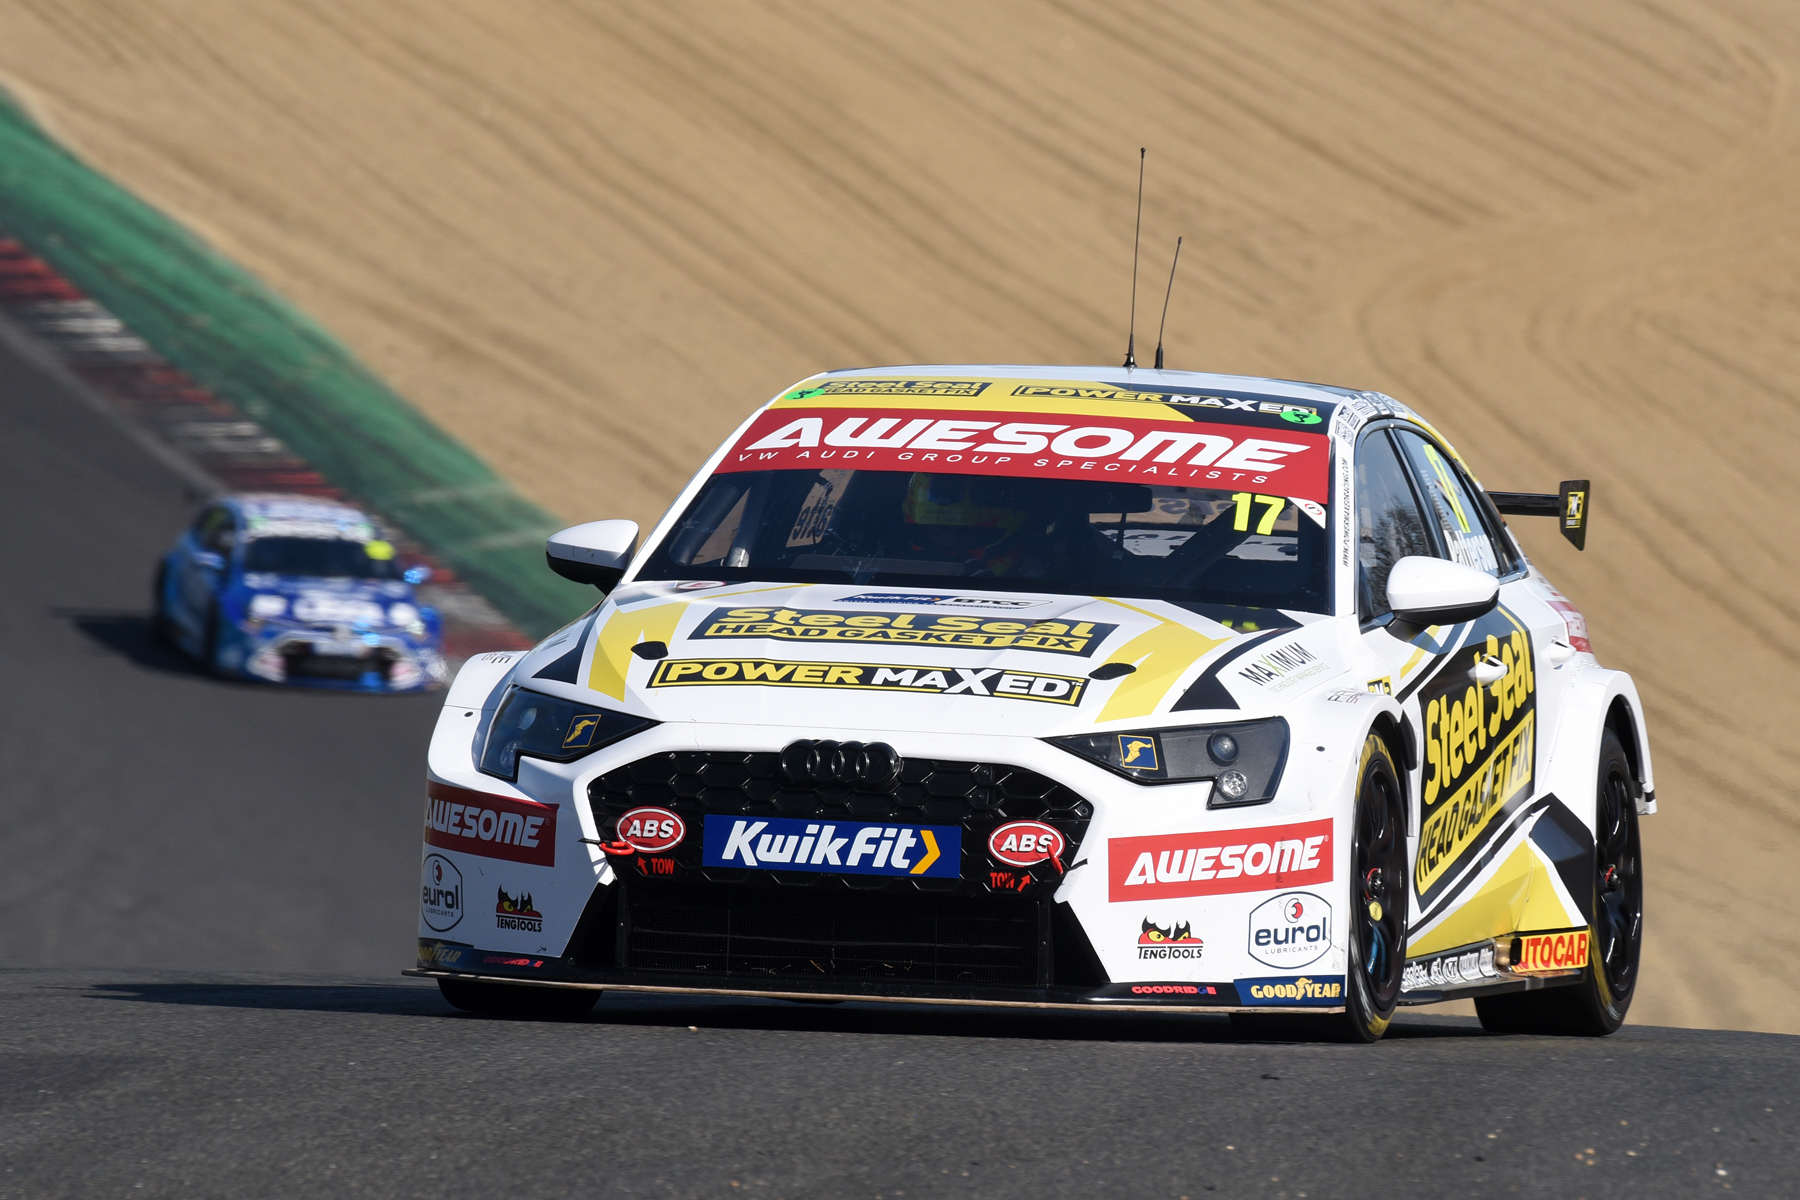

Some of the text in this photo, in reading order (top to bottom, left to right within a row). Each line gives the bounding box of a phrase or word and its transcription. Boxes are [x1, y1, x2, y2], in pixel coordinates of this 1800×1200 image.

[825, 381, 984, 390] Steel Seal
[1025, 386, 1164, 402] POWER
[744, 417, 1311, 473] AWESOME
[739, 450, 1269, 484] VW AUDI GROUP SPECIALISTS
[1232, 492, 1285, 536] 17
[712, 624, 1083, 649] HEAD GASKET FIX
[717, 607, 1097, 638] Steel Seal
[1238, 642, 1318, 687] MAXIMUM
[665, 662, 864, 684] POWER
[870, 668, 1071, 697] MAXED
[1424, 651, 1487, 806] Steel
[1418, 800, 1461, 883] HEAD
[1508, 720, 1532, 790] FIX
[626, 819, 675, 838] ABS
[1000, 834, 1054, 853] ABS
[651, 857, 675, 875] TOW
[1123, 834, 1325, 886] AWESOME
[990, 872, 1015, 889] TOW
[422, 885, 460, 909] eurol
[425, 907, 455, 918] LUBRICANTS
[1255, 916, 1327, 947] eurol
[1264, 944, 1319, 955] LUBRICANTS
[1514, 933, 1587, 971] UTOCAR
[1131, 985, 1217, 995] GOODRIDGE
